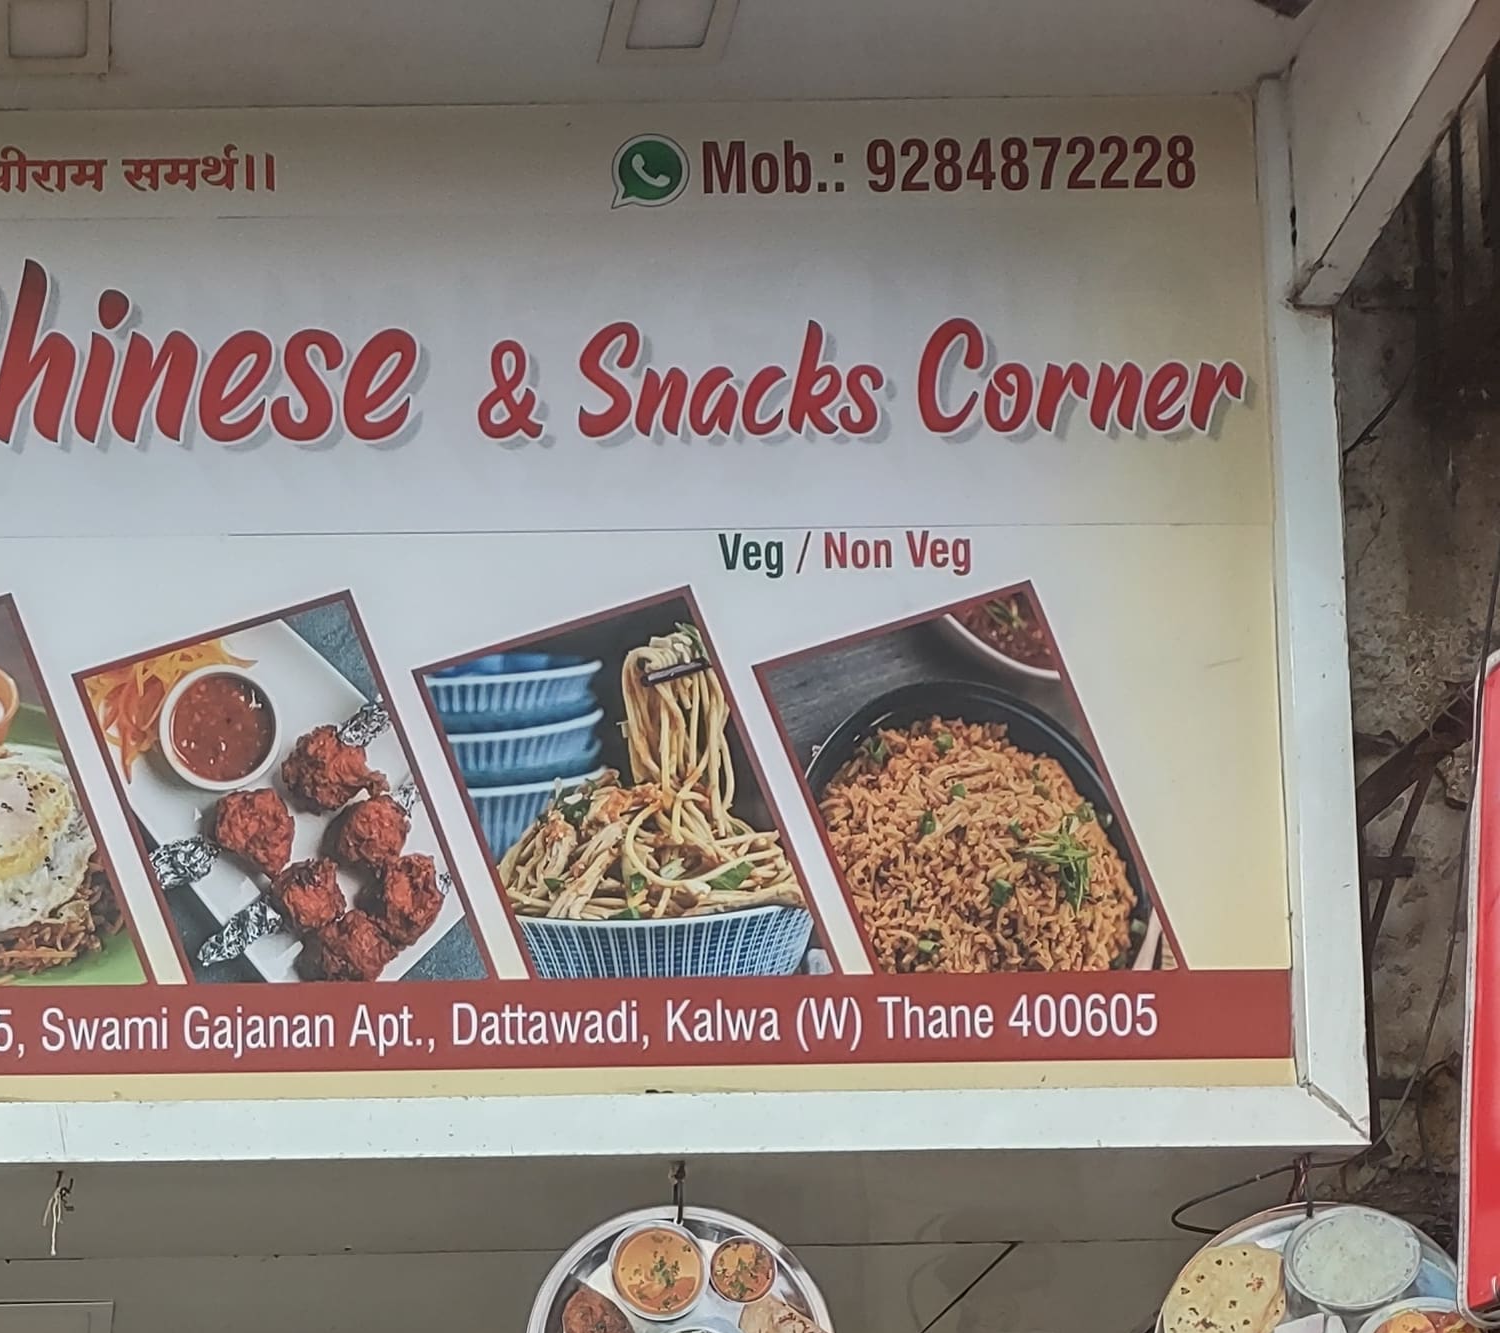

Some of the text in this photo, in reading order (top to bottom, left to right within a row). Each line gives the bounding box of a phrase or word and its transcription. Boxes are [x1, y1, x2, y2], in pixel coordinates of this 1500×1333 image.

[702, 135, 1196, 195] Mob.: 9284872228
[478, 339, 544, 440] &
[577, 319, 883, 440] Snacks
[917, 316, 1245, 434] Corner
[718, 529, 974, 579] Veg / Non Veg
[41, 1006, 169, 1052] Swami
[183, 1005, 336, 1058] Gajanan
[348, 1003, 436, 1056] Apt.,
[451, 1000, 651, 1051] Dattawadi,
[665, 998, 781, 1044] Kalwa
[795, 995, 864, 1052] (W)
[877, 995, 995, 1040] Thane
[1008, 992, 1159, 1039] 400605
